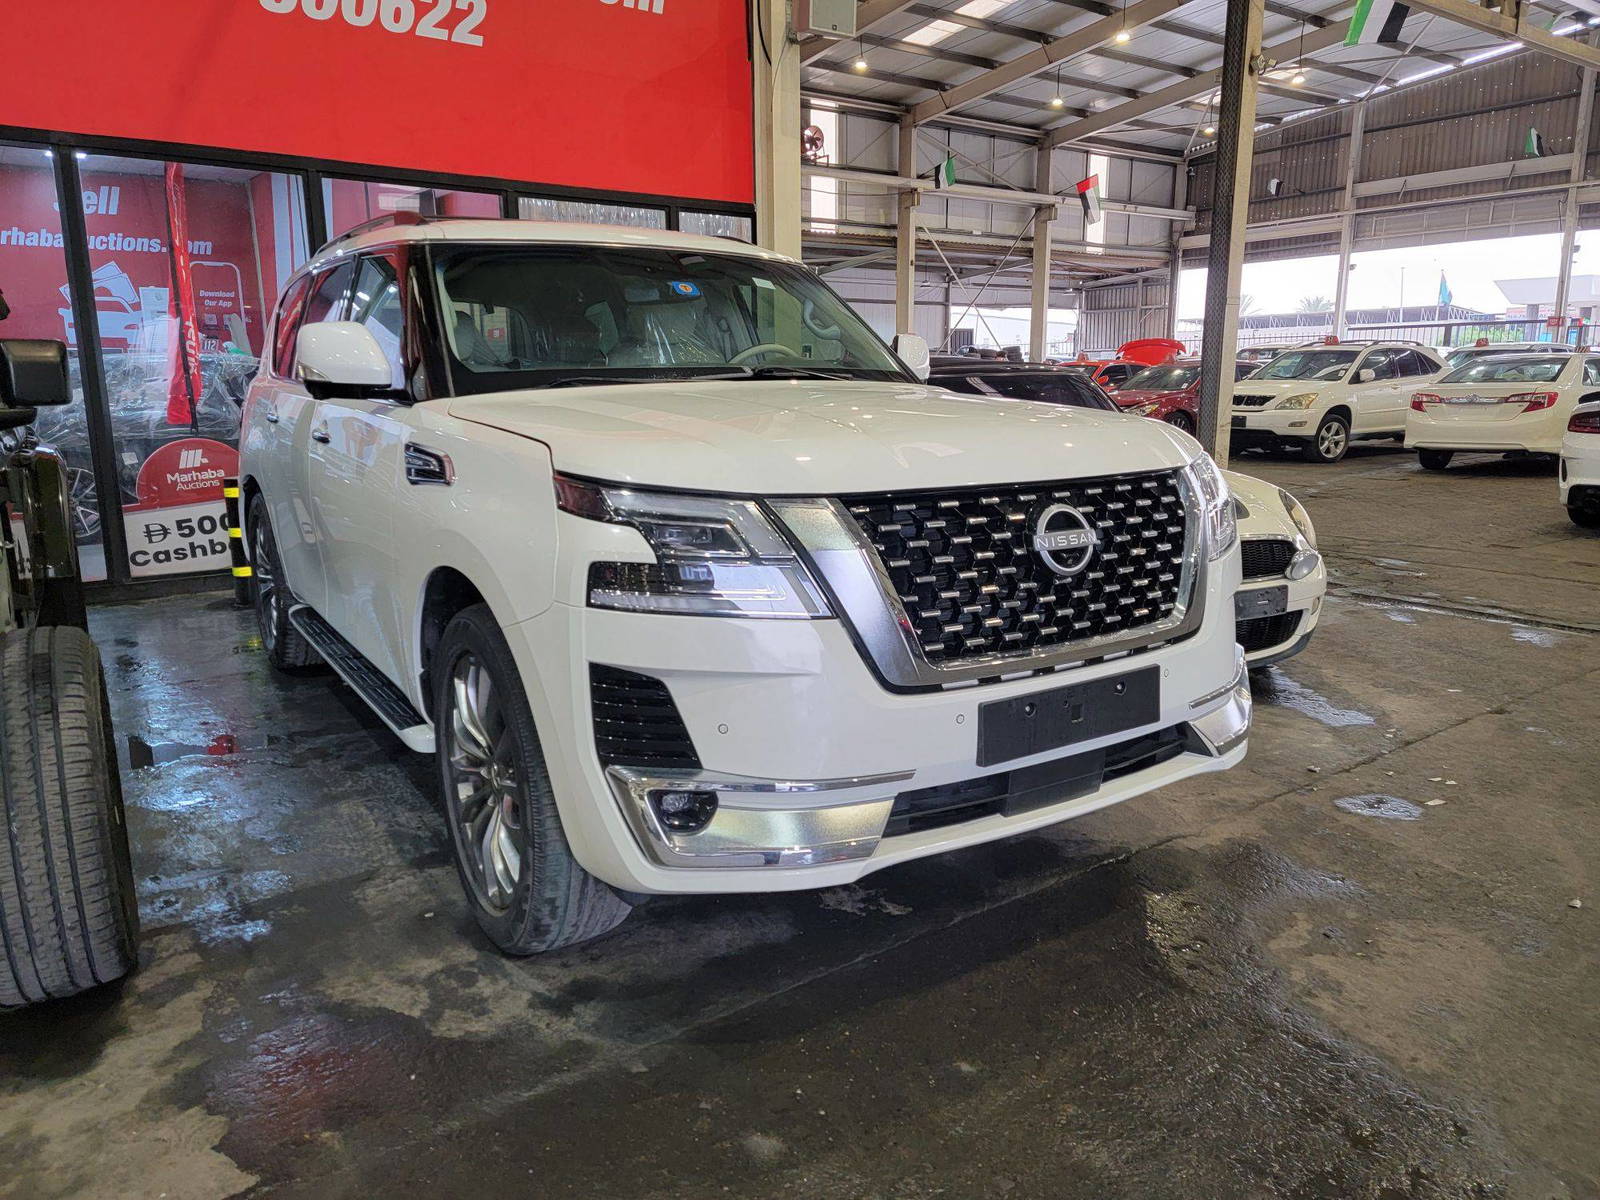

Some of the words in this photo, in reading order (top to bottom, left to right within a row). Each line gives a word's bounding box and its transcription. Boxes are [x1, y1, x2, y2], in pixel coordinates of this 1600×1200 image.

[53, 185, 120, 215] ell
[199, 289, 235, 298] Download
[204, 299, 218, 307] Our
[219, 300, 233, 308] App
[166, 468, 225, 484] Marhaba
[176, 479, 221, 492] Auctions
[1036, 531, 1097, 549] NISSAN
[129, 538, 232, 567] Cashb
